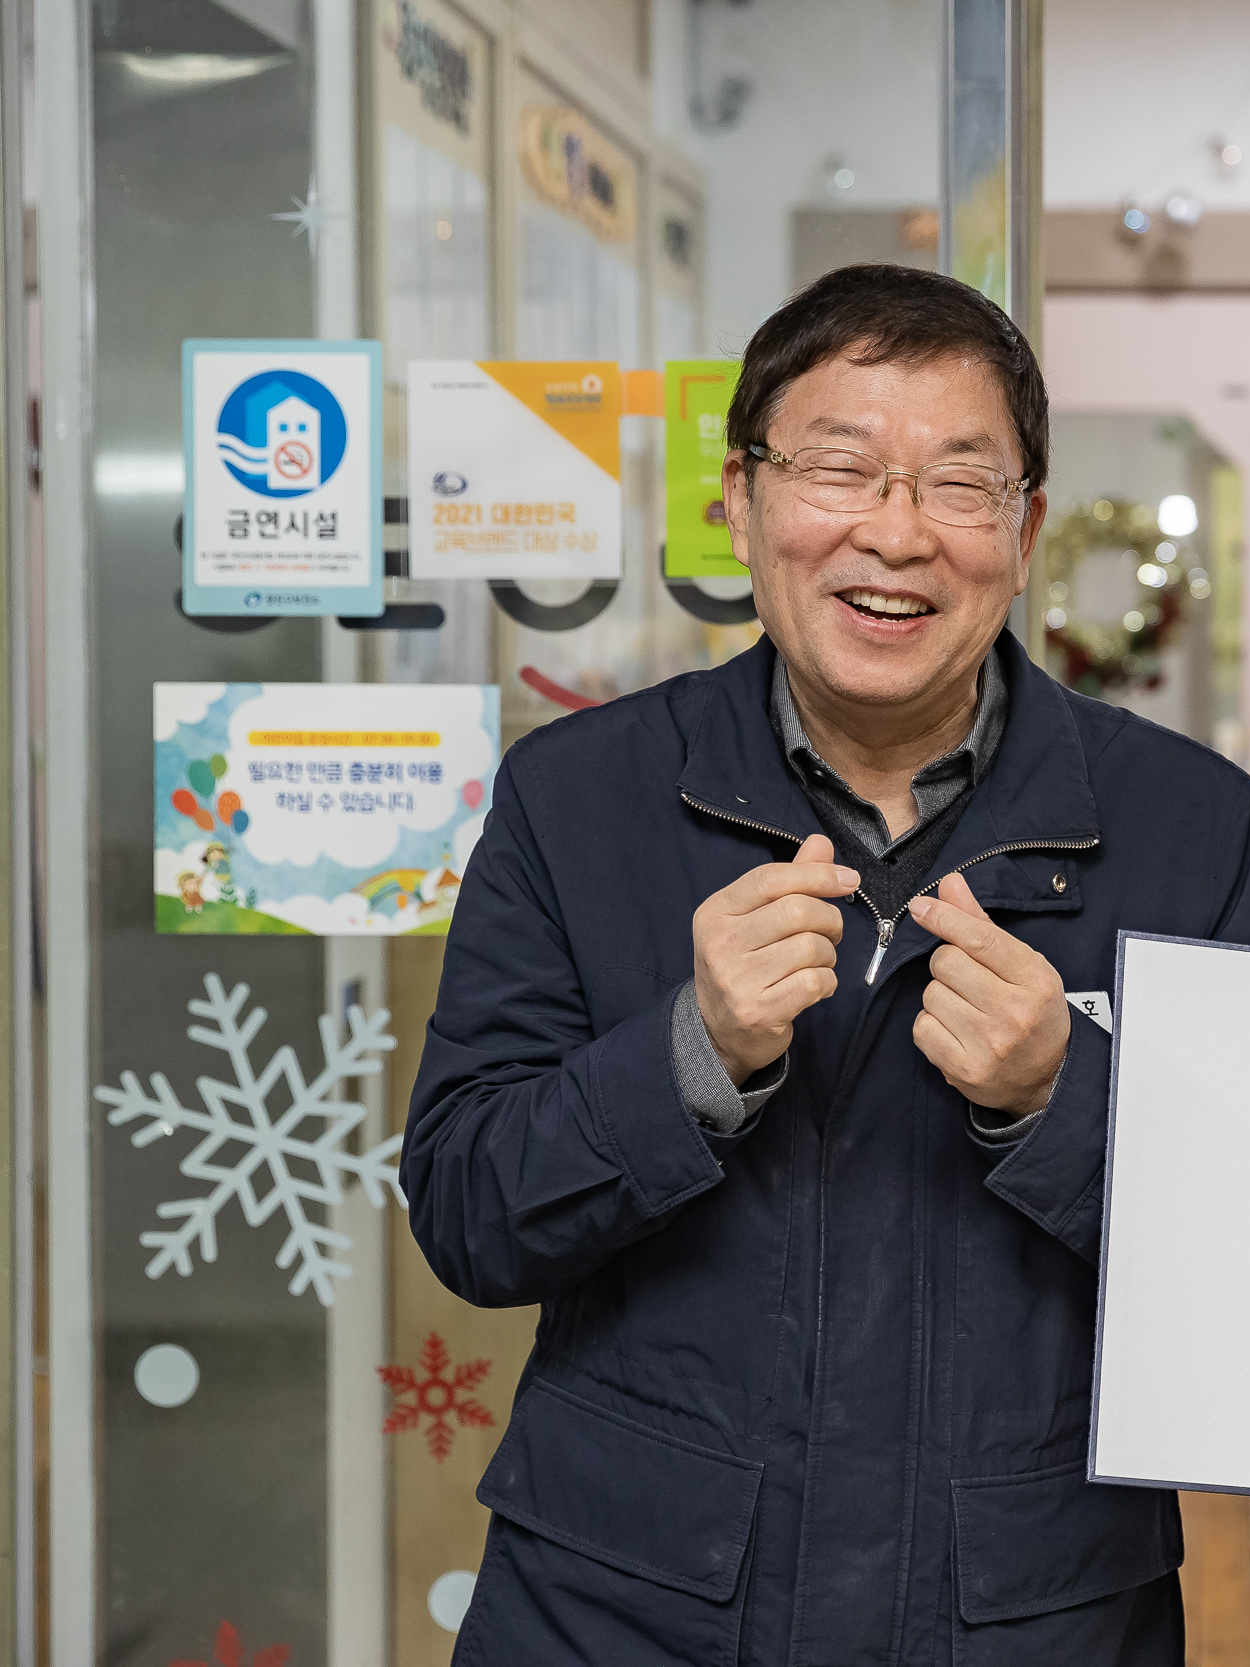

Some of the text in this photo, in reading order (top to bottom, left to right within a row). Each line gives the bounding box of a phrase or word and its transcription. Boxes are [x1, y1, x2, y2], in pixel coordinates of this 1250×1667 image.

[226, 509, 338, 540] 금연시설
[432, 502, 576, 526] 2021 대한민국
